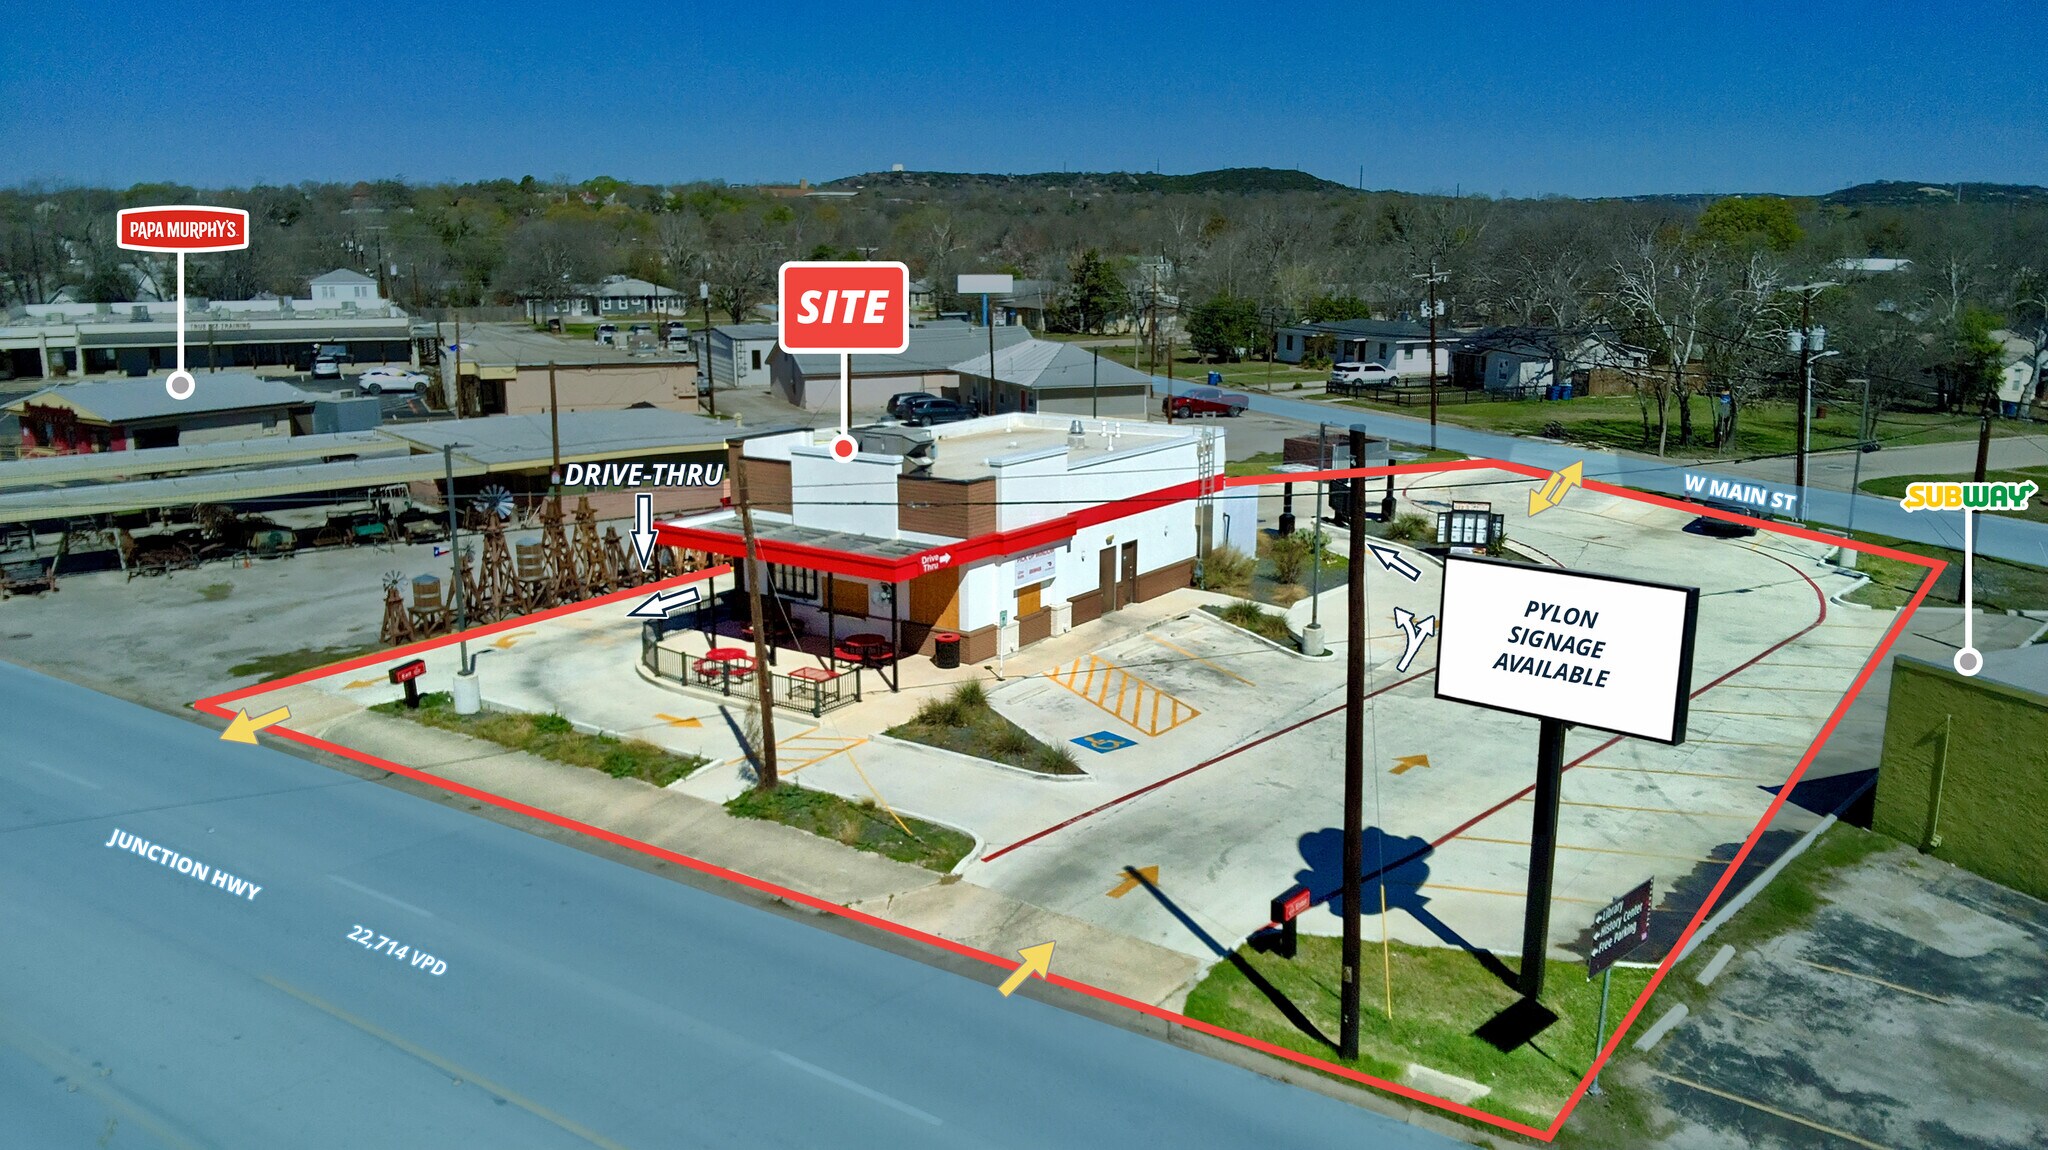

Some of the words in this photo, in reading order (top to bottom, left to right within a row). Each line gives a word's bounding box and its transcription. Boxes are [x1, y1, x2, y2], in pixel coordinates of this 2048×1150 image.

[921, 554, 939, 565] Drive
[923, 563, 939, 572] Thru
[1600, 916, 1622, 937] History
[1623, 902, 1643, 922] Center
[1602, 900, 1624, 921] Library
[1599, 937, 1613, 953] Free
[1613, 921, 1637, 944] Parking
